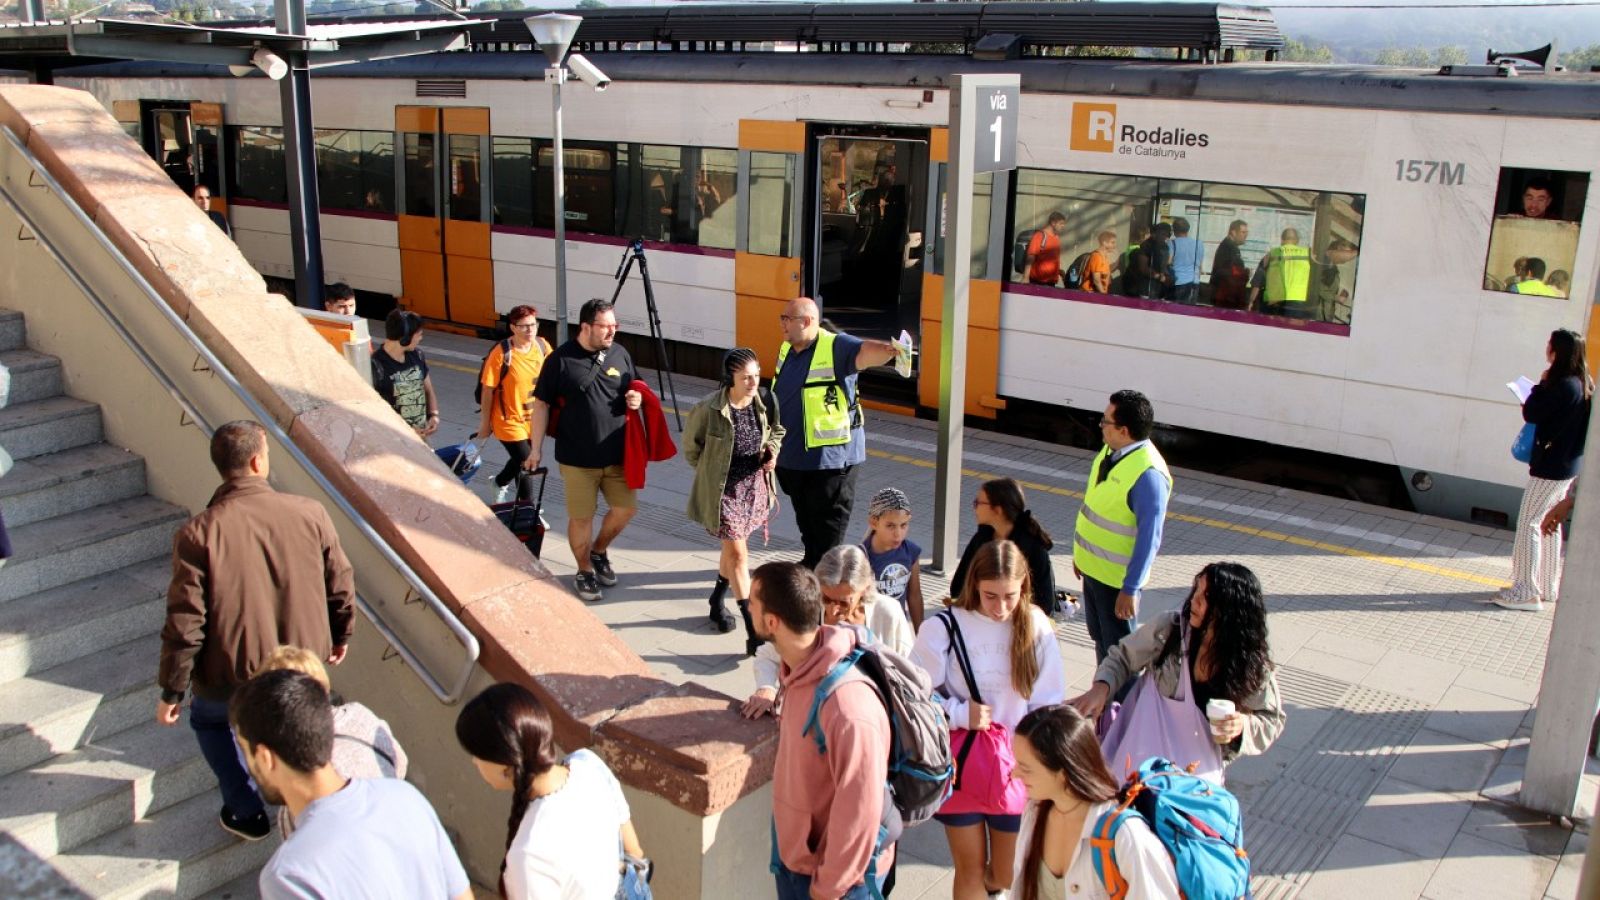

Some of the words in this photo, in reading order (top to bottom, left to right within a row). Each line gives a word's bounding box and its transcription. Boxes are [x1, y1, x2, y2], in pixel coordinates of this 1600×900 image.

[989, 115, 1002, 162] 1
[1088, 110, 1115, 141] R
[1120, 124, 1210, 148] Rodalies
[1118, 144, 1132, 155] de
[1134, 145, 1187, 160] Catalunya
[1395, 159, 1466, 186] 157M
